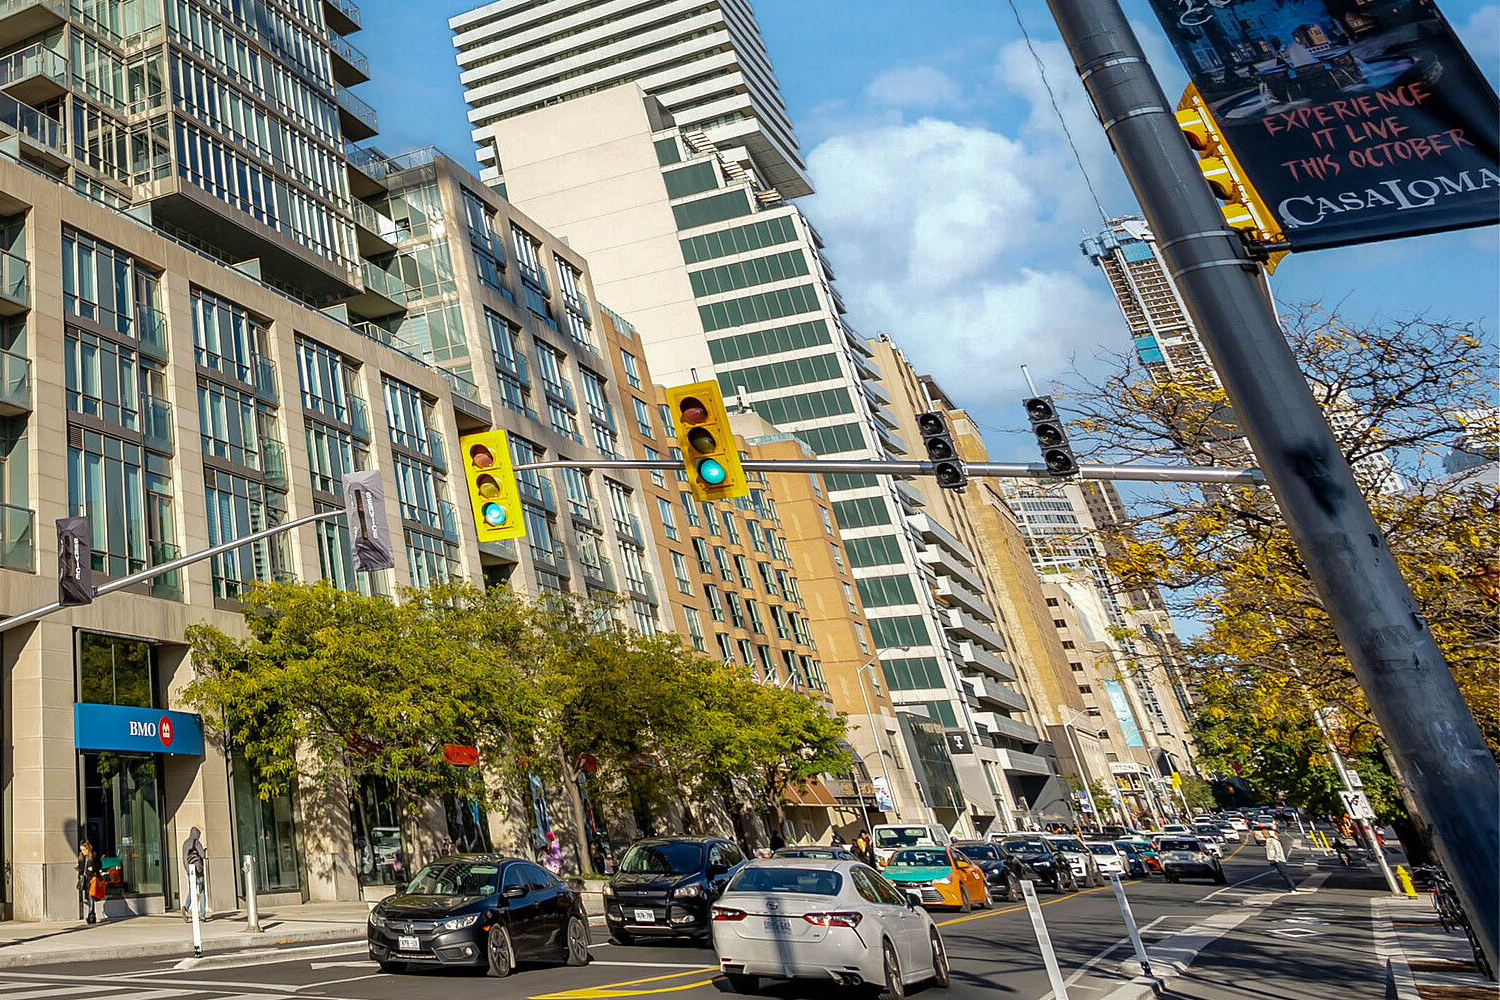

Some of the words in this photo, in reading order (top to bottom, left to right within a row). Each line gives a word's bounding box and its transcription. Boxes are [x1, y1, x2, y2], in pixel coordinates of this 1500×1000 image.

[1262, 81, 1433, 136] EXPERIENCE
[1281, 153, 1341, 182] THIS
[1348, 128, 1477, 167] OCTOBER
[1311, 127, 1338, 149] IT
[1344, 116, 1410, 143] LIVE
[366, 491, 379, 539] SERVICE
[73, 537, 82, 580] SERVICE
[129, 720, 156, 737] BMO
